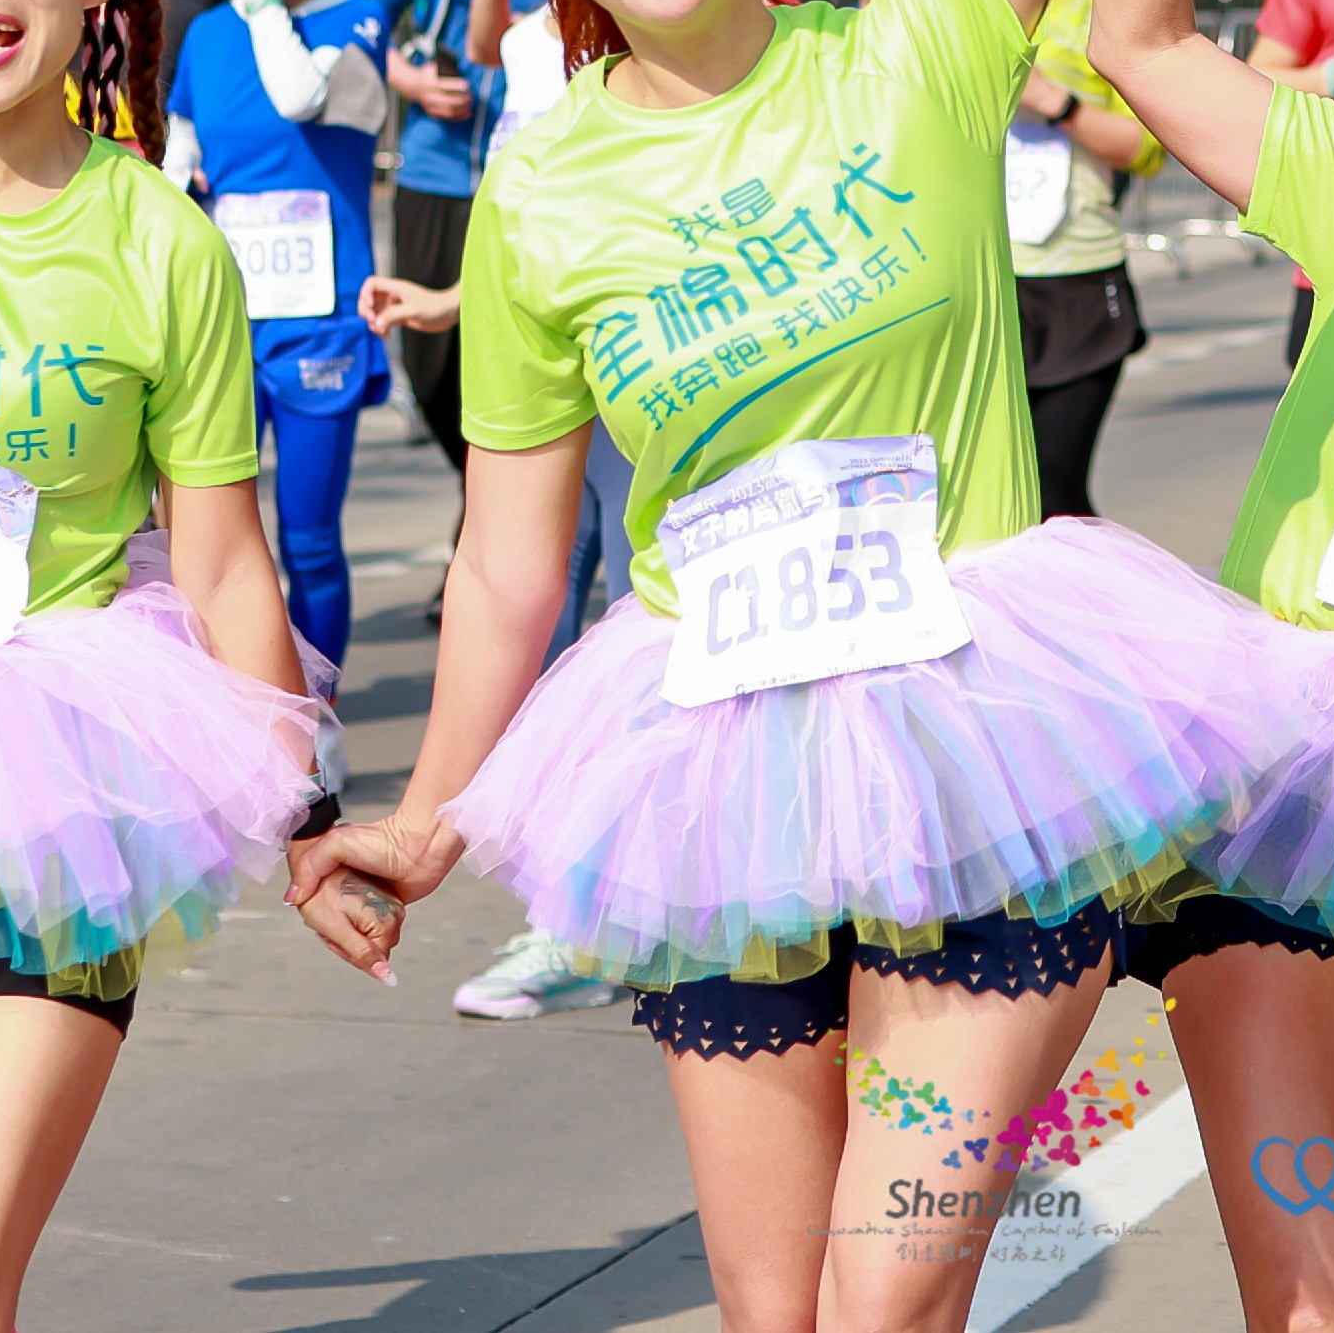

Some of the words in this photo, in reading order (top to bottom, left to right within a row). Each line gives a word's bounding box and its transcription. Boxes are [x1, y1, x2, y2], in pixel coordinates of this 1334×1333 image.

[668, 178, 776, 253] 我是
[591, 143, 915, 405] 全棉时代
[638, 332, 768, 431] 我奔跑
[707, 530, 914, 656] C1853
